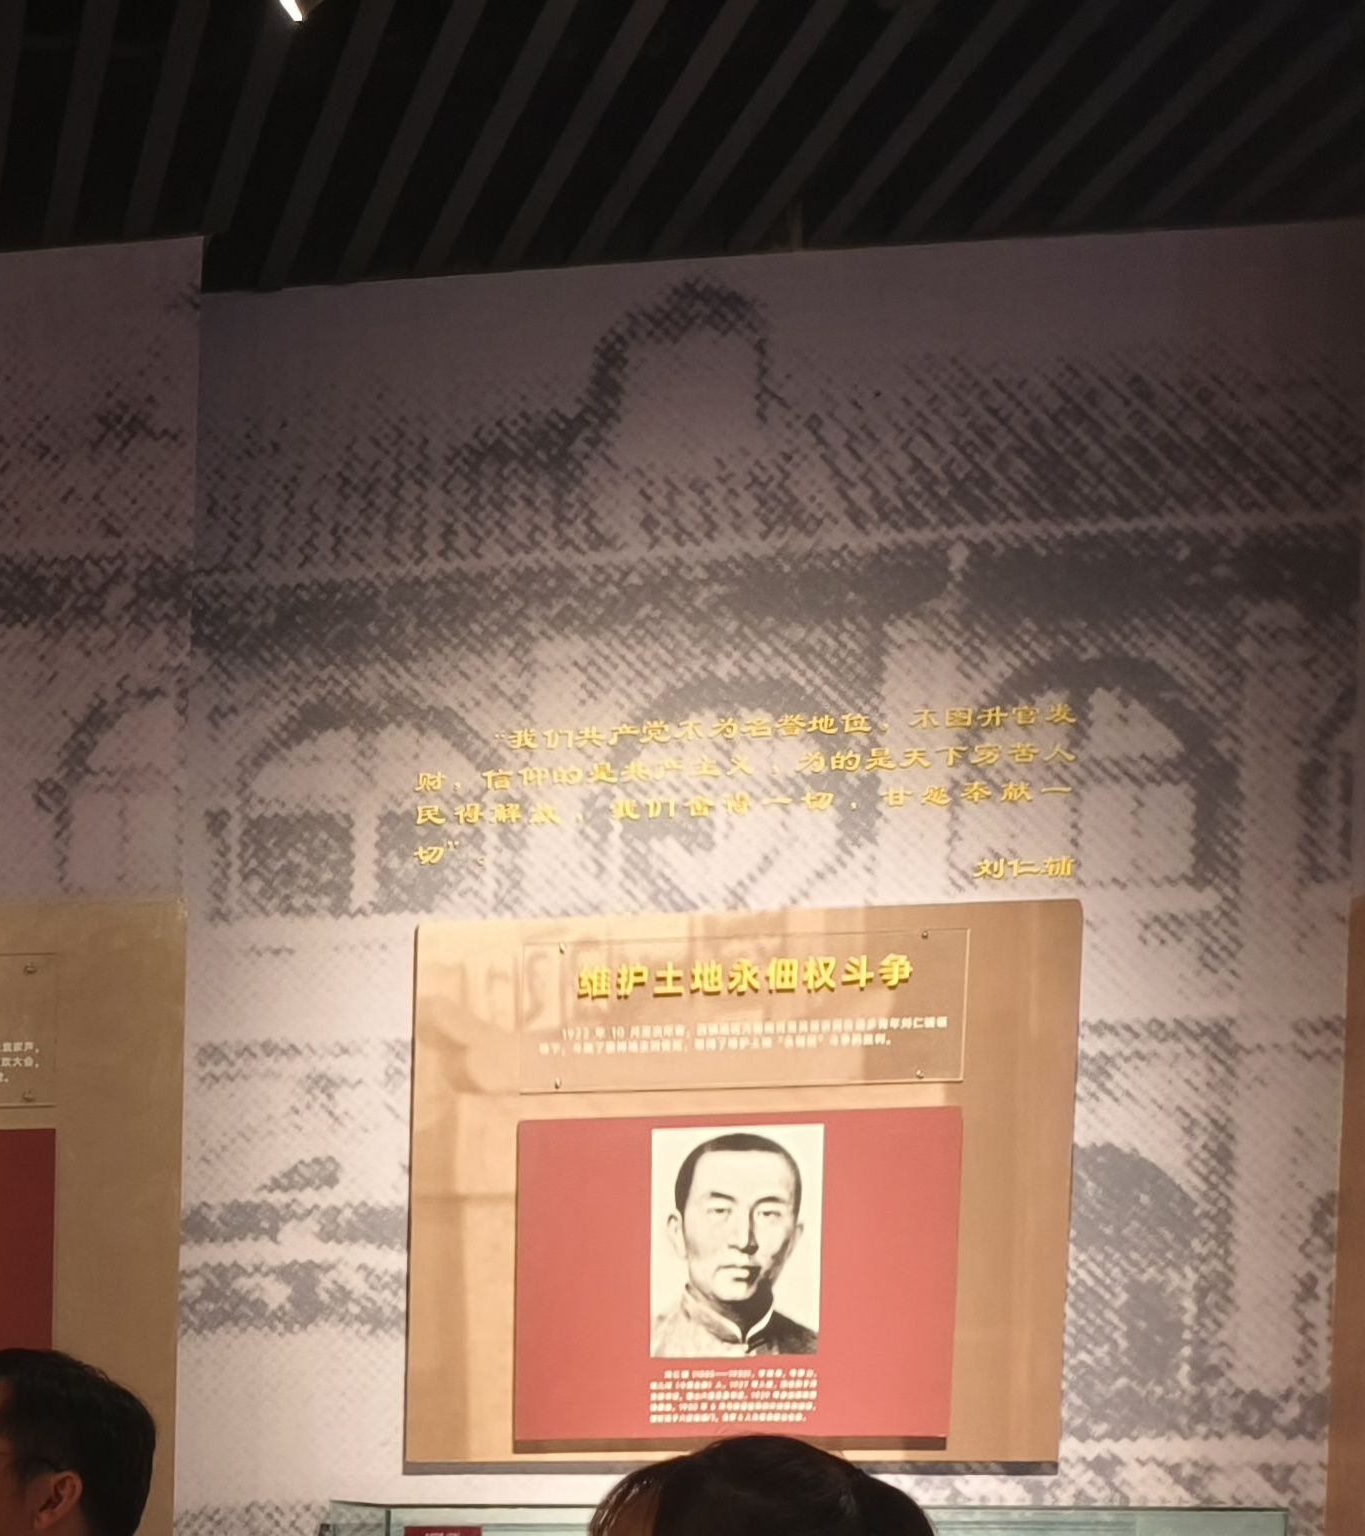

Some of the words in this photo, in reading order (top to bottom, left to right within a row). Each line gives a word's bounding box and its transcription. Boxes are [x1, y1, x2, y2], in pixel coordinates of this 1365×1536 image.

[577, 953, 914, 999] 维护土地永佃权斗争
